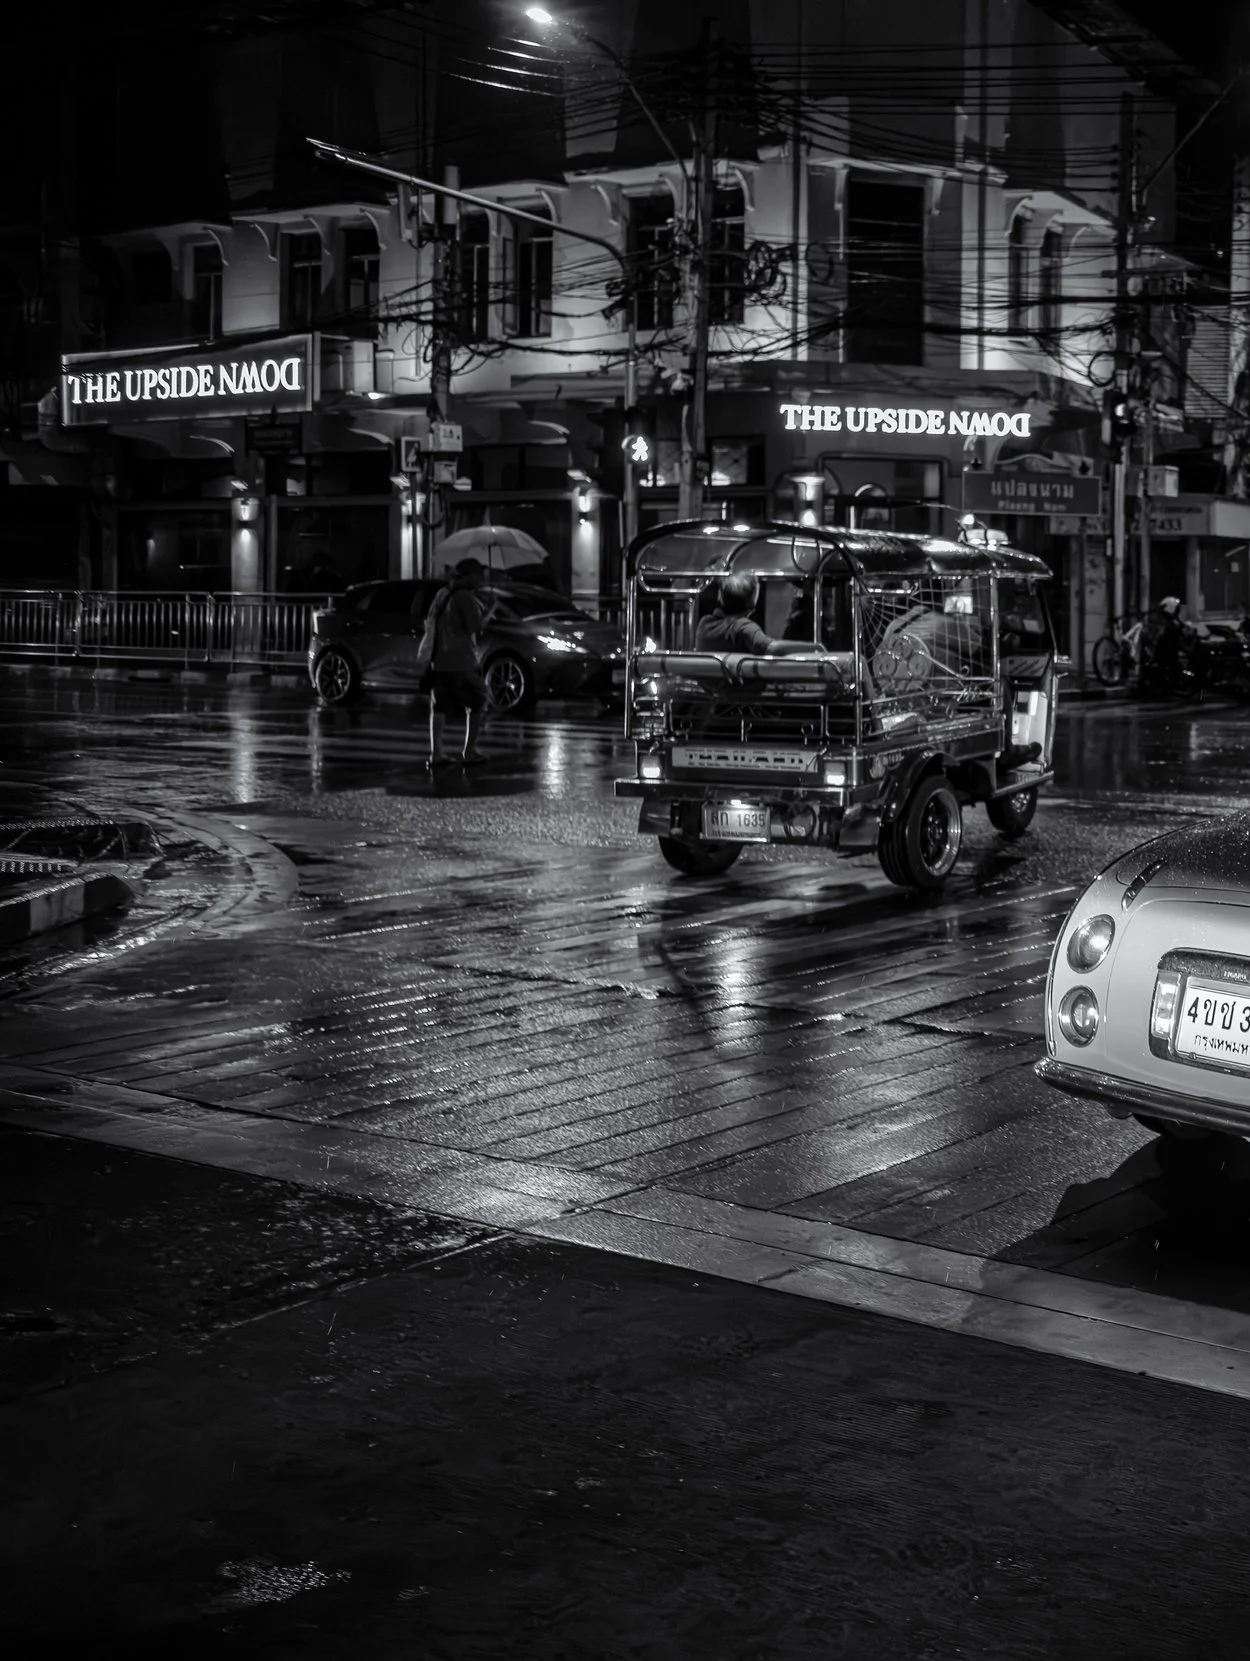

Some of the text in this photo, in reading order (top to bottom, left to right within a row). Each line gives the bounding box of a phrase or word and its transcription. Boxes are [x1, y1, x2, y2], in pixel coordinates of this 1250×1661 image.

[68, 372, 122, 404] THE
[124, 364, 215, 401] UPSIDE
[780, 404, 842, 432] THE
[844, 406, 946, 434] UPSIDE
[737, 813, 766, 828] 1635
